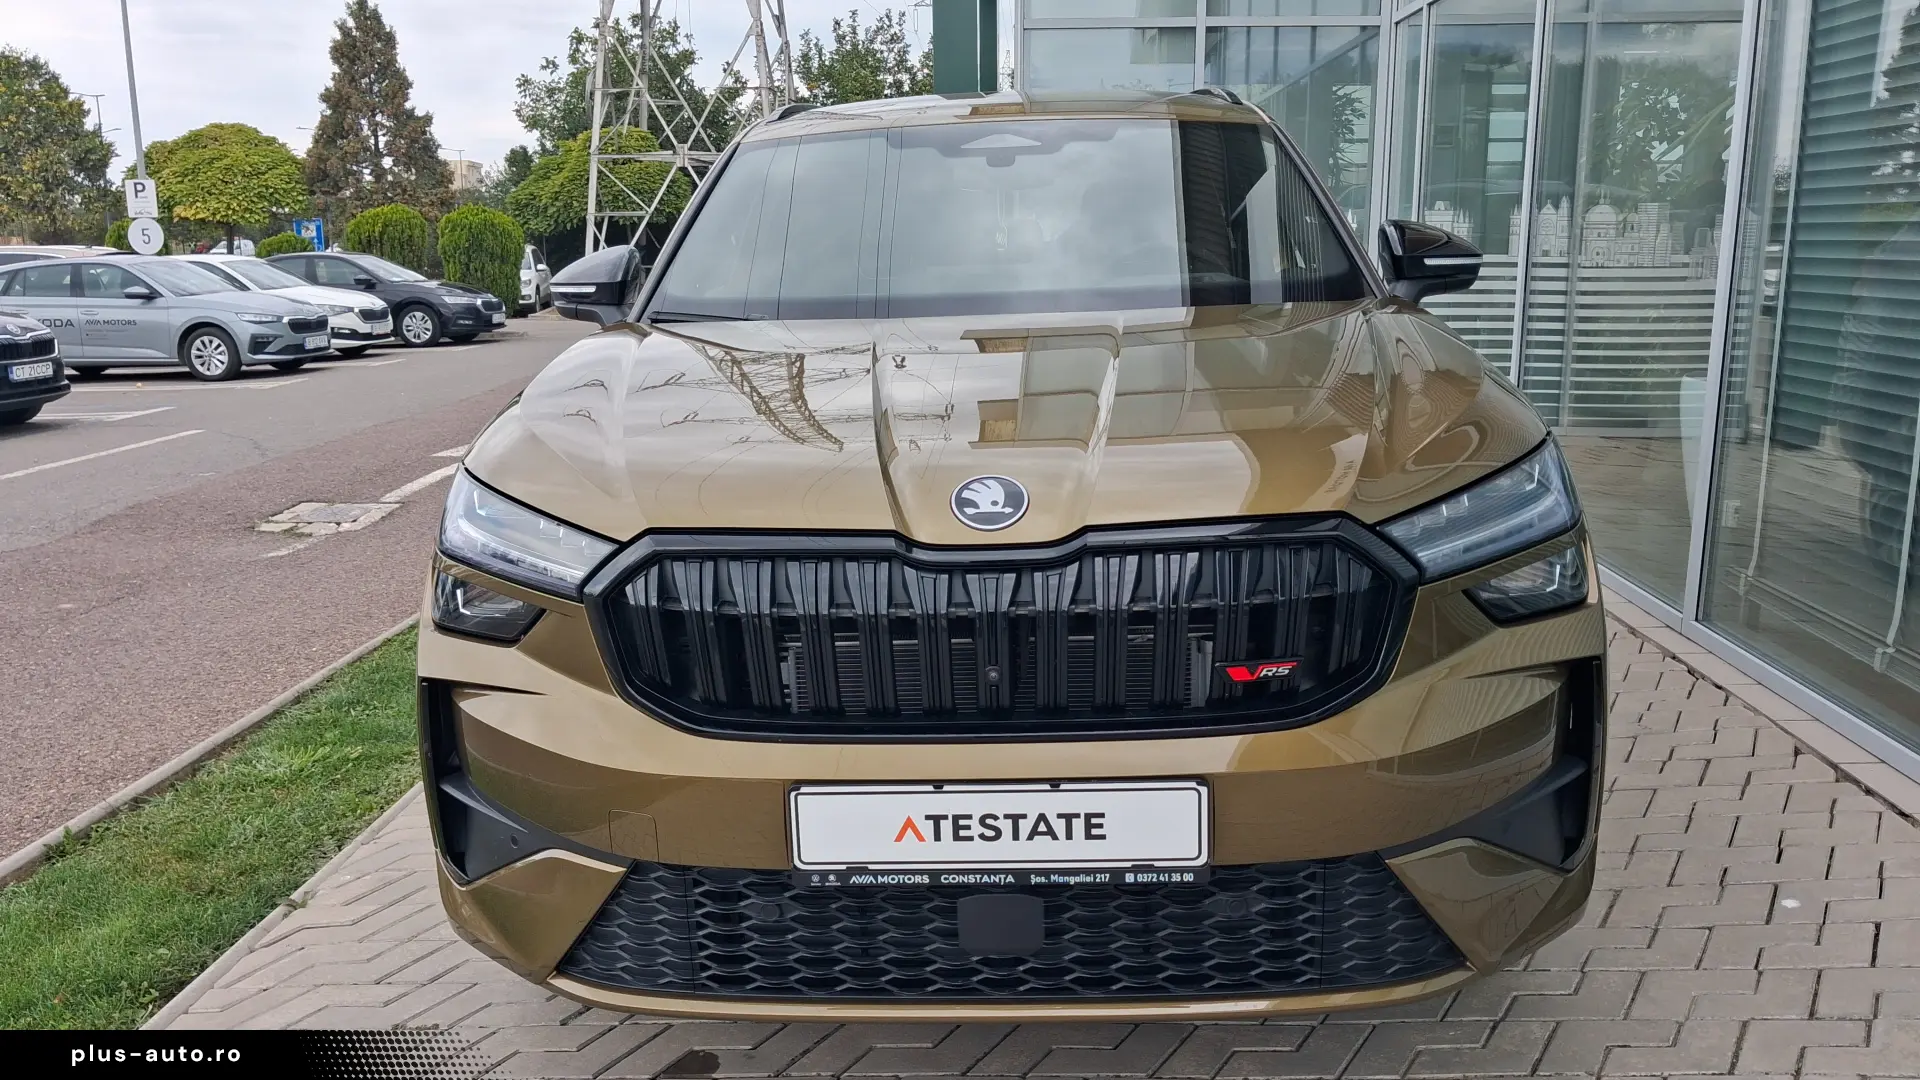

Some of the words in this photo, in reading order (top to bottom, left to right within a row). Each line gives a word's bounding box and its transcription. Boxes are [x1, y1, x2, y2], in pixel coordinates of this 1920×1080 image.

[133, 181, 146, 199] P
[141, 227, 151, 245] 5
[37, 318, 75, 328] ODA
[15, 366, 25, 378] CT
[877, 874, 930, 884] MOTORS
[1050, 874, 1094, 885] Mangaliei
[1095, 874, 1110, 883] 217
[1136, 873, 1157, 882] 0372
[1159, 873, 1169, 882] 41
[1170, 873, 1181, 882] 35
[1183, 873, 1194, 882] 00
